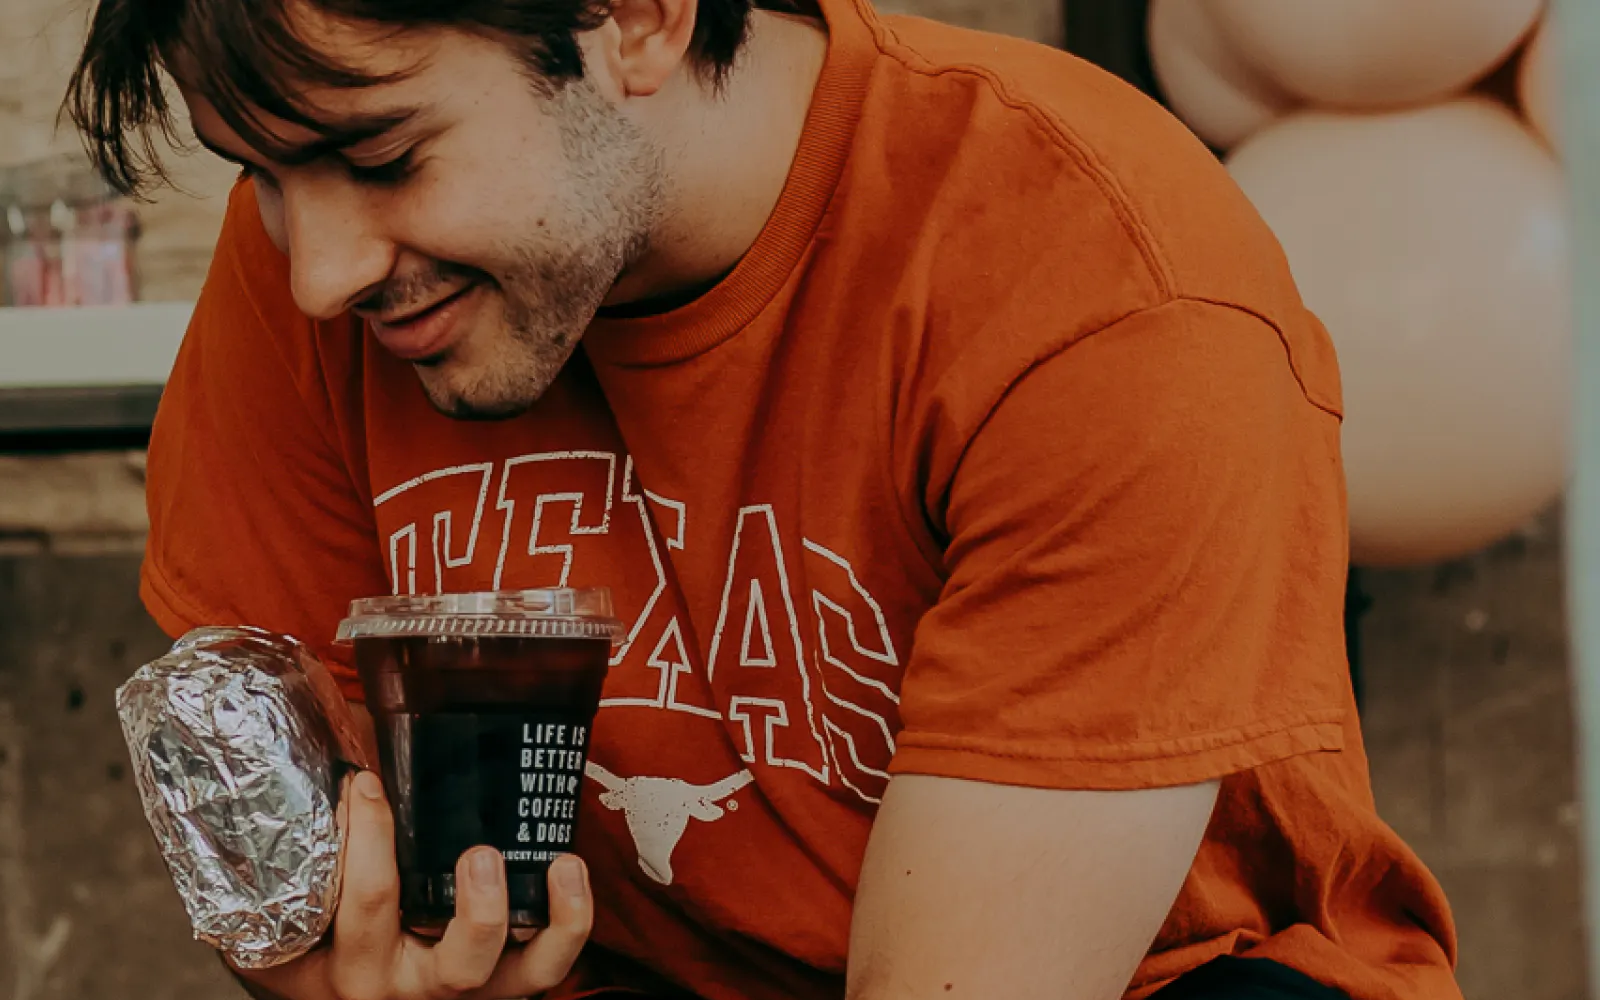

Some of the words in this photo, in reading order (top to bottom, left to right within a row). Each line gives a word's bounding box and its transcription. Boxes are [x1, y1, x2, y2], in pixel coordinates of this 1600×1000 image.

[373, 450, 899, 803] TEXAS
[523, 723, 566, 744] LIFE
[572, 726, 586, 746] IS
[521, 748, 582, 769] BETTER
[521, 773, 564, 793] WITH
[518, 798, 575, 818] COFFEE
[517, 822, 530, 842] &
[536, 822, 571, 842] DOGS
